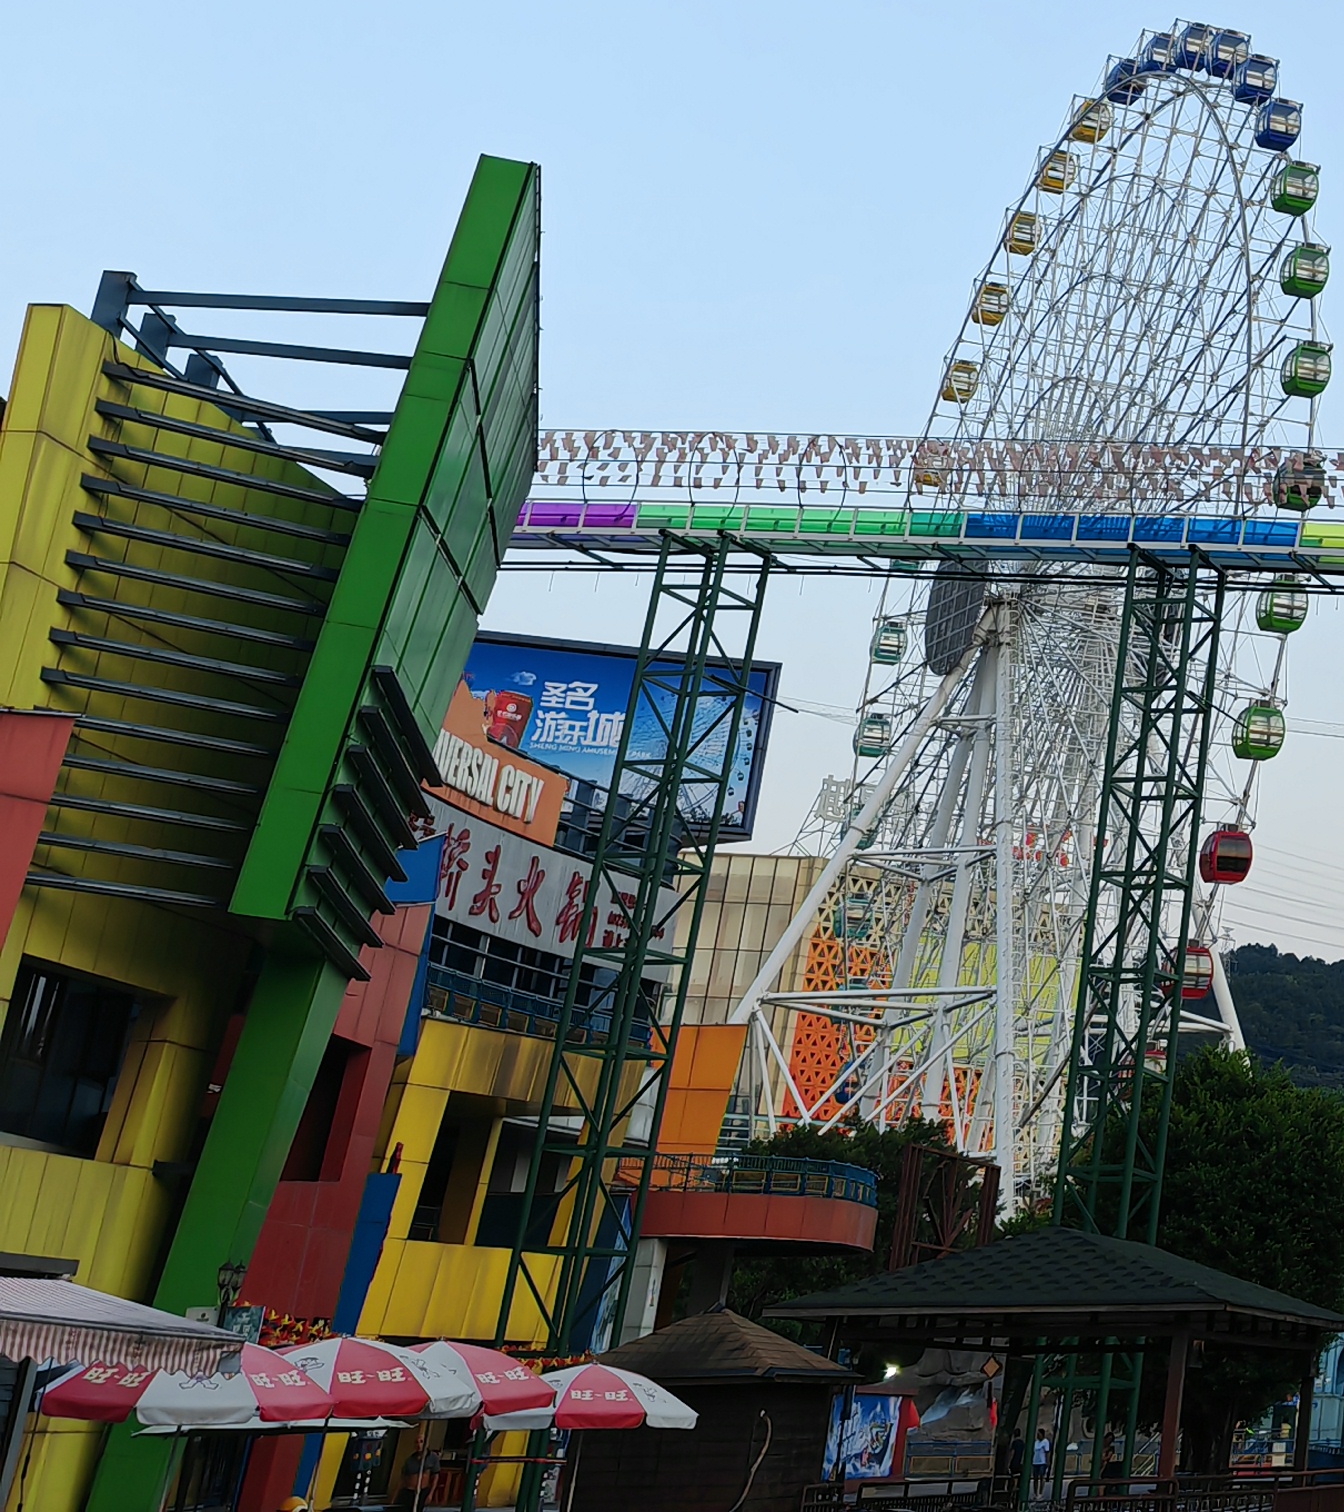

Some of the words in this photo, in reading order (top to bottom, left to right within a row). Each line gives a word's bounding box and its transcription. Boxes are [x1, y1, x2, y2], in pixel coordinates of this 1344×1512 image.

[540, 681, 599, 711] 圣名
[529, 742, 557, 752] SHENG
[432, 728, 499, 806] IVERSAL
[497, 764, 544, 824] CITY
